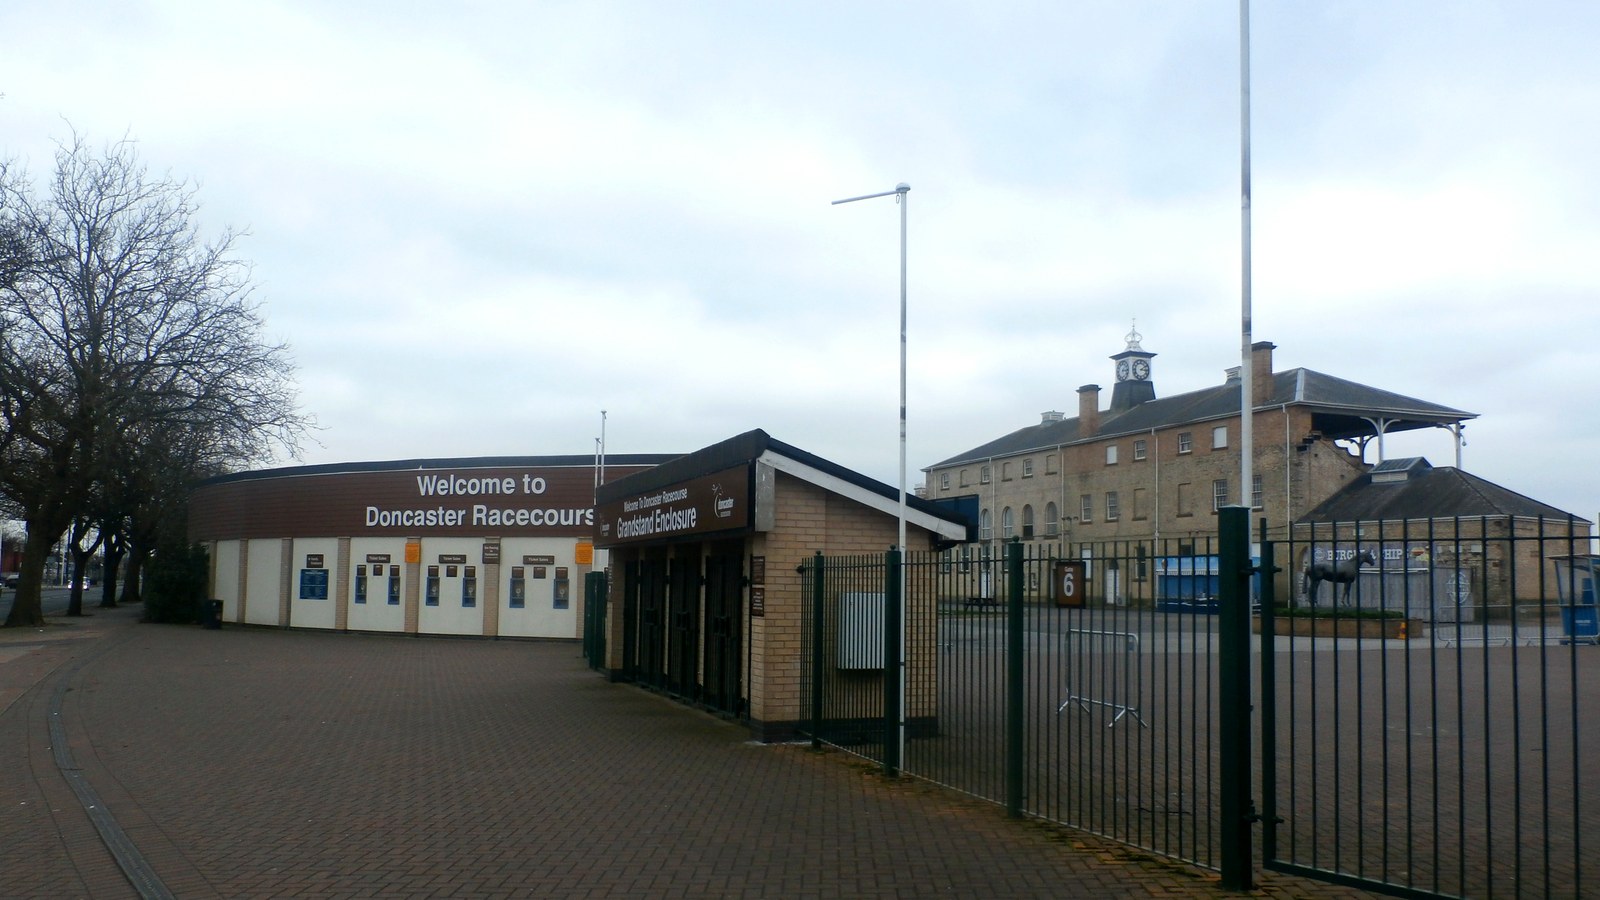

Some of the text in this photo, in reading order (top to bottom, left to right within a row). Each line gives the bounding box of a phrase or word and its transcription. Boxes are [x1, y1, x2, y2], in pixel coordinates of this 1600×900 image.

[416, 473, 546, 496] Welcome to
[624, 500, 639, 512] Welcome
[643, 493, 662, 508] Doncaster
[663, 488, 688, 503] Racecourse
[365, 504, 594, 527] Doncaster Racecours
[617, 511, 654, 538] Grandstand
[655, 506, 697, 533] Enclosure
[1327, 549, 1366, 561] BURG
[1382, 548, 1409, 560] HIP
[1064, 573, 1074, 596] 6
